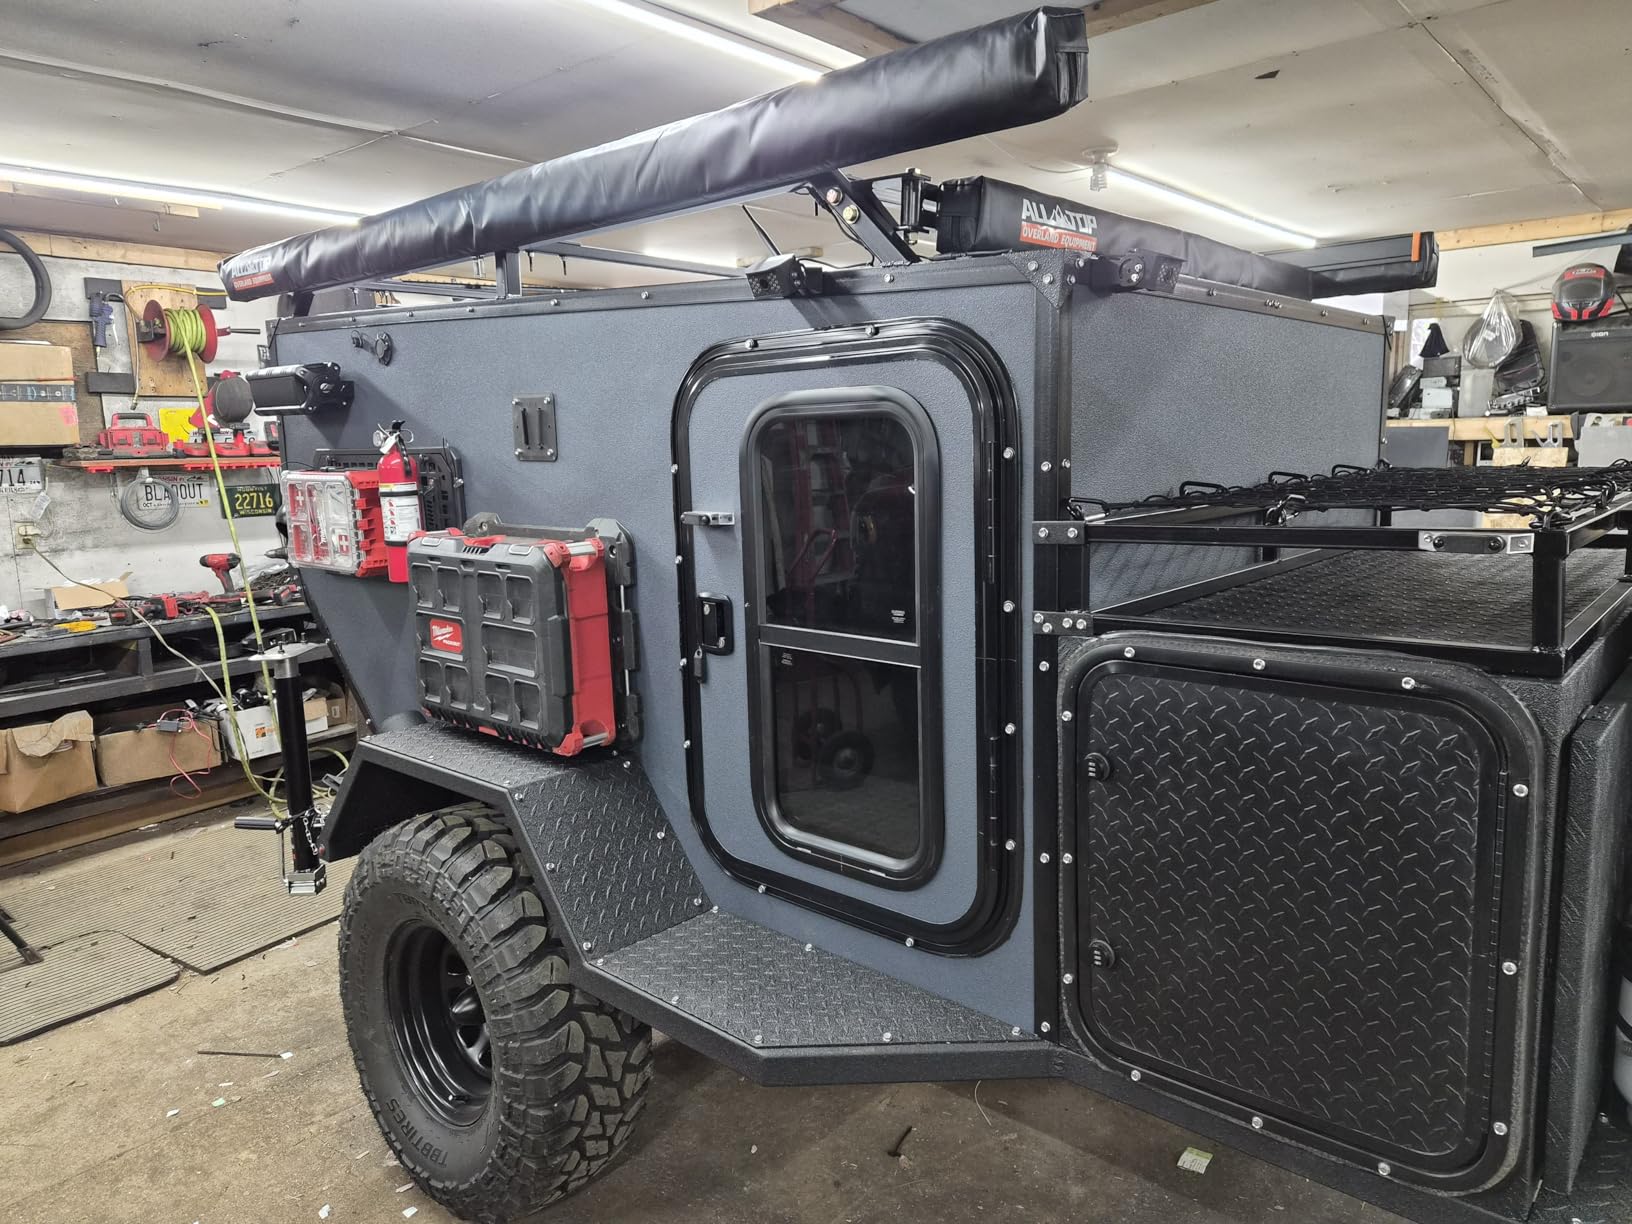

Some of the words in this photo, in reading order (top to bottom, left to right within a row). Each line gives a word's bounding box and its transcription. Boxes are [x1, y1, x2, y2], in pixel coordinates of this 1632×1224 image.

[1022, 226, 1059, 244] OVERLAND
[1061, 234, 1097, 252] EQUIPMENT
[234, 492, 274, 510] 22716
